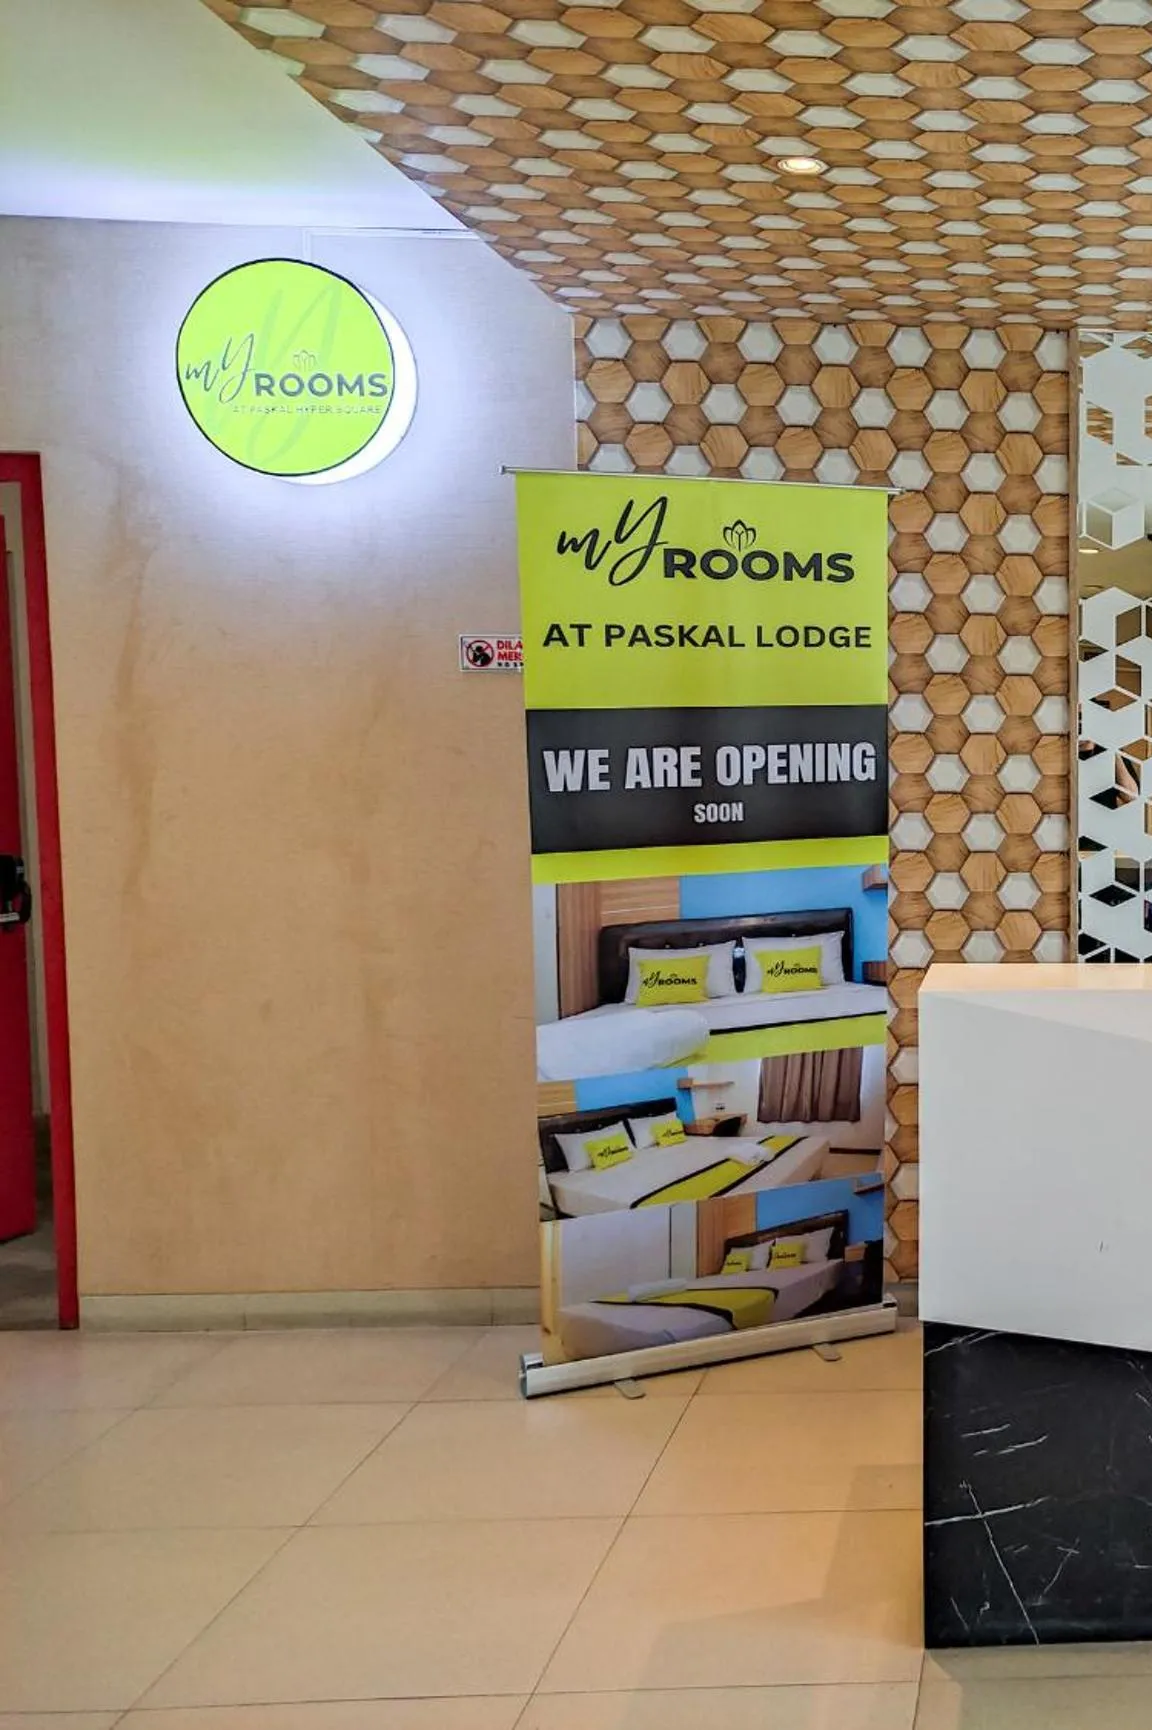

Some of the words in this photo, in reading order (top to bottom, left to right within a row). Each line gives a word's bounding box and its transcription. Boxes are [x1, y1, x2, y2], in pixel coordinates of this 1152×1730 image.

[255, 373, 388, 397] ROOMS
[250, 405, 293, 414] PASKAL
[296, 405, 331, 414] HYPER
[663, 548, 855, 583] ROOMS
[543, 623, 593, 648] AT
[604, 623, 745, 648] PASKAL
[756, 625, 872, 648] LODGE
[543, 749, 611, 792] WE
[625, 746, 702, 789] ARE
[715, 742, 877, 786] OPENING
[694, 802, 744, 823] SOON
[658, 977, 698, 986] ROOMS
